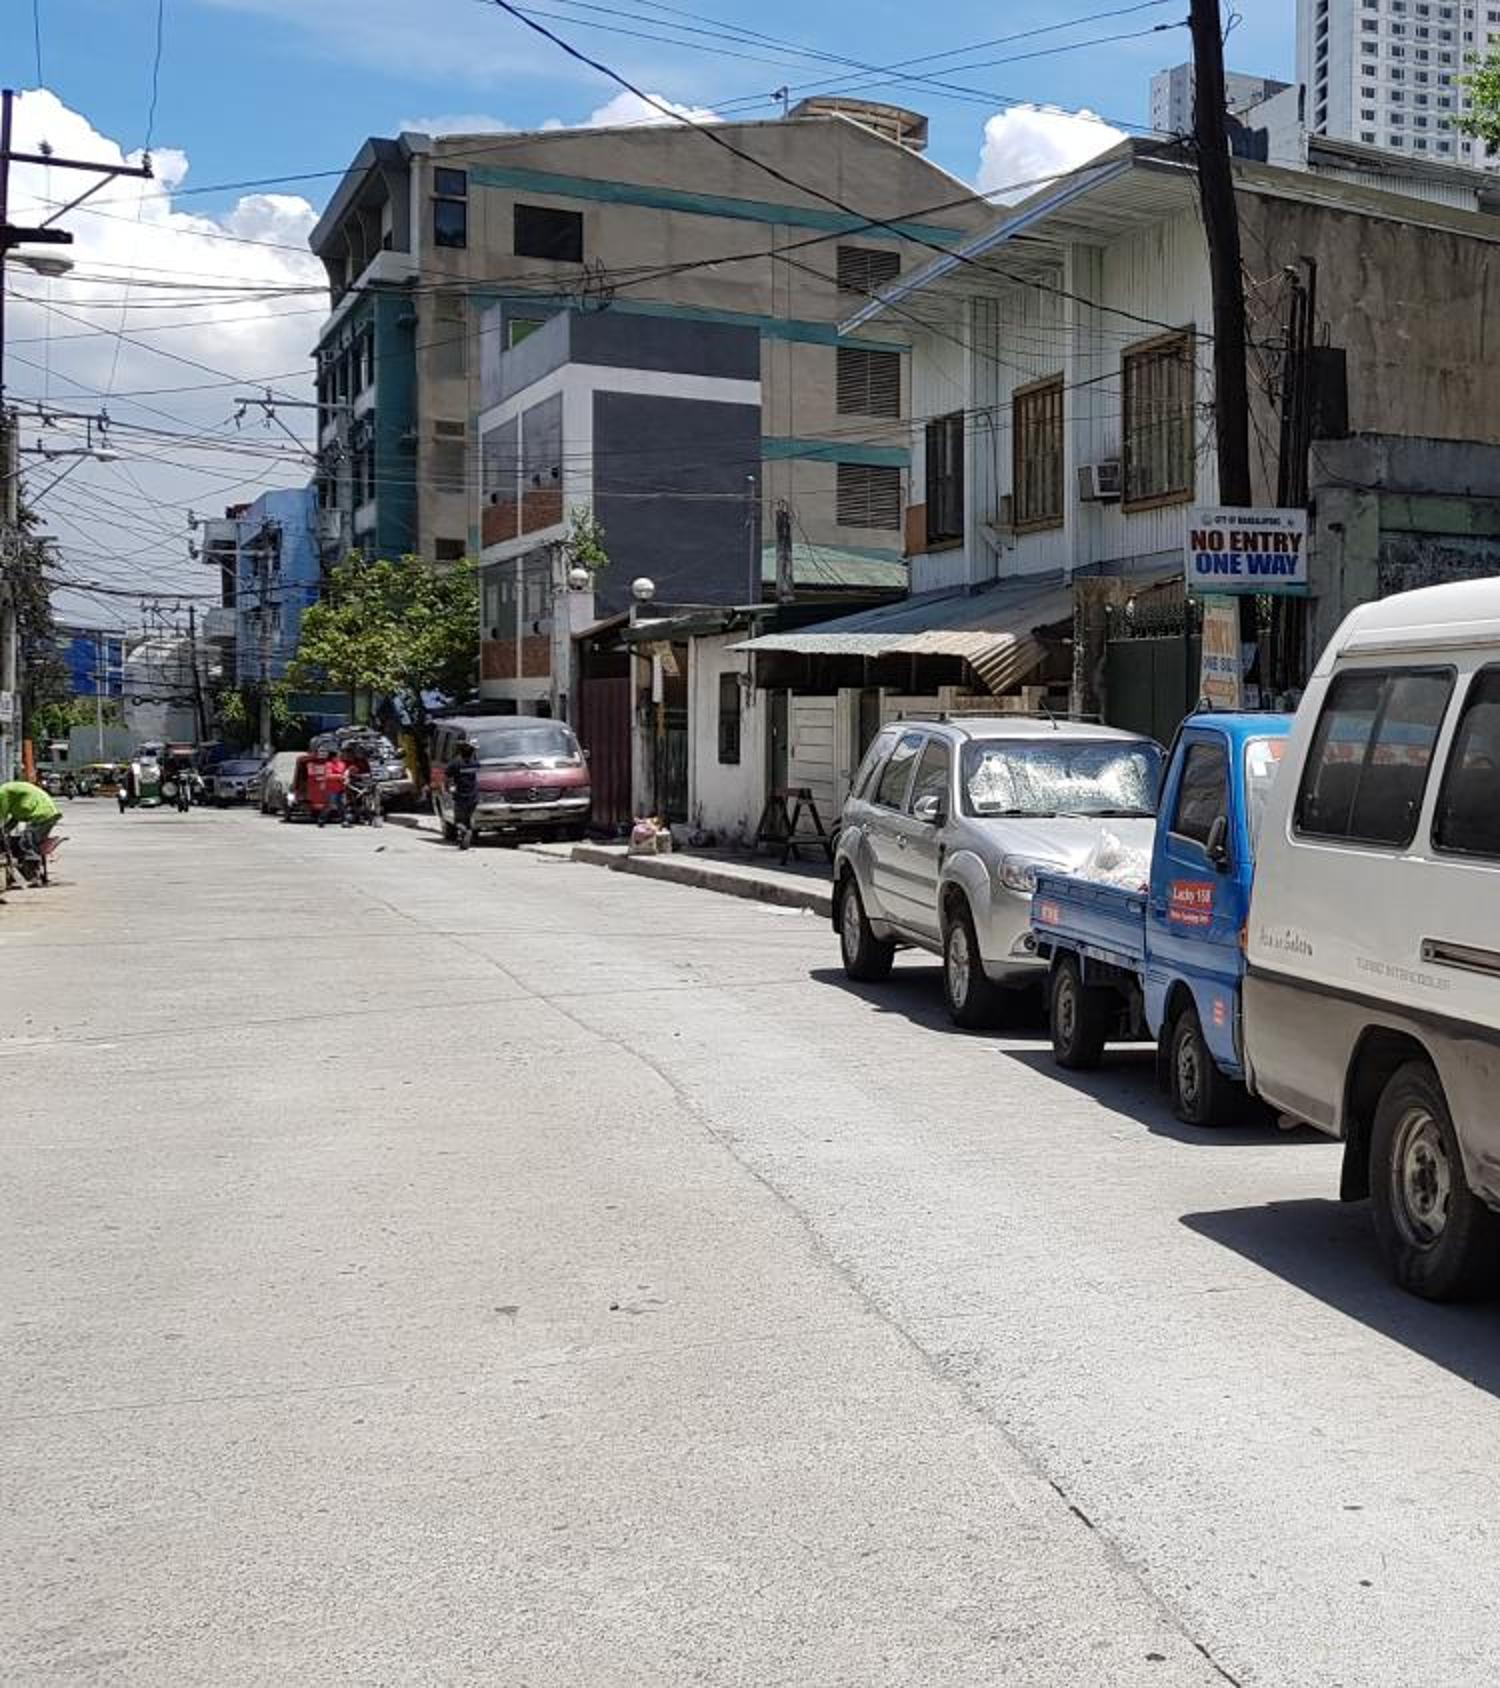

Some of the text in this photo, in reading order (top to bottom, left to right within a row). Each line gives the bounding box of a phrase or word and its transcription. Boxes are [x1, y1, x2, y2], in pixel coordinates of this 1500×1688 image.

[1190, 529, 1302, 553] NO ENTRY
[1195, 553, 1299, 576] ONE WAY
